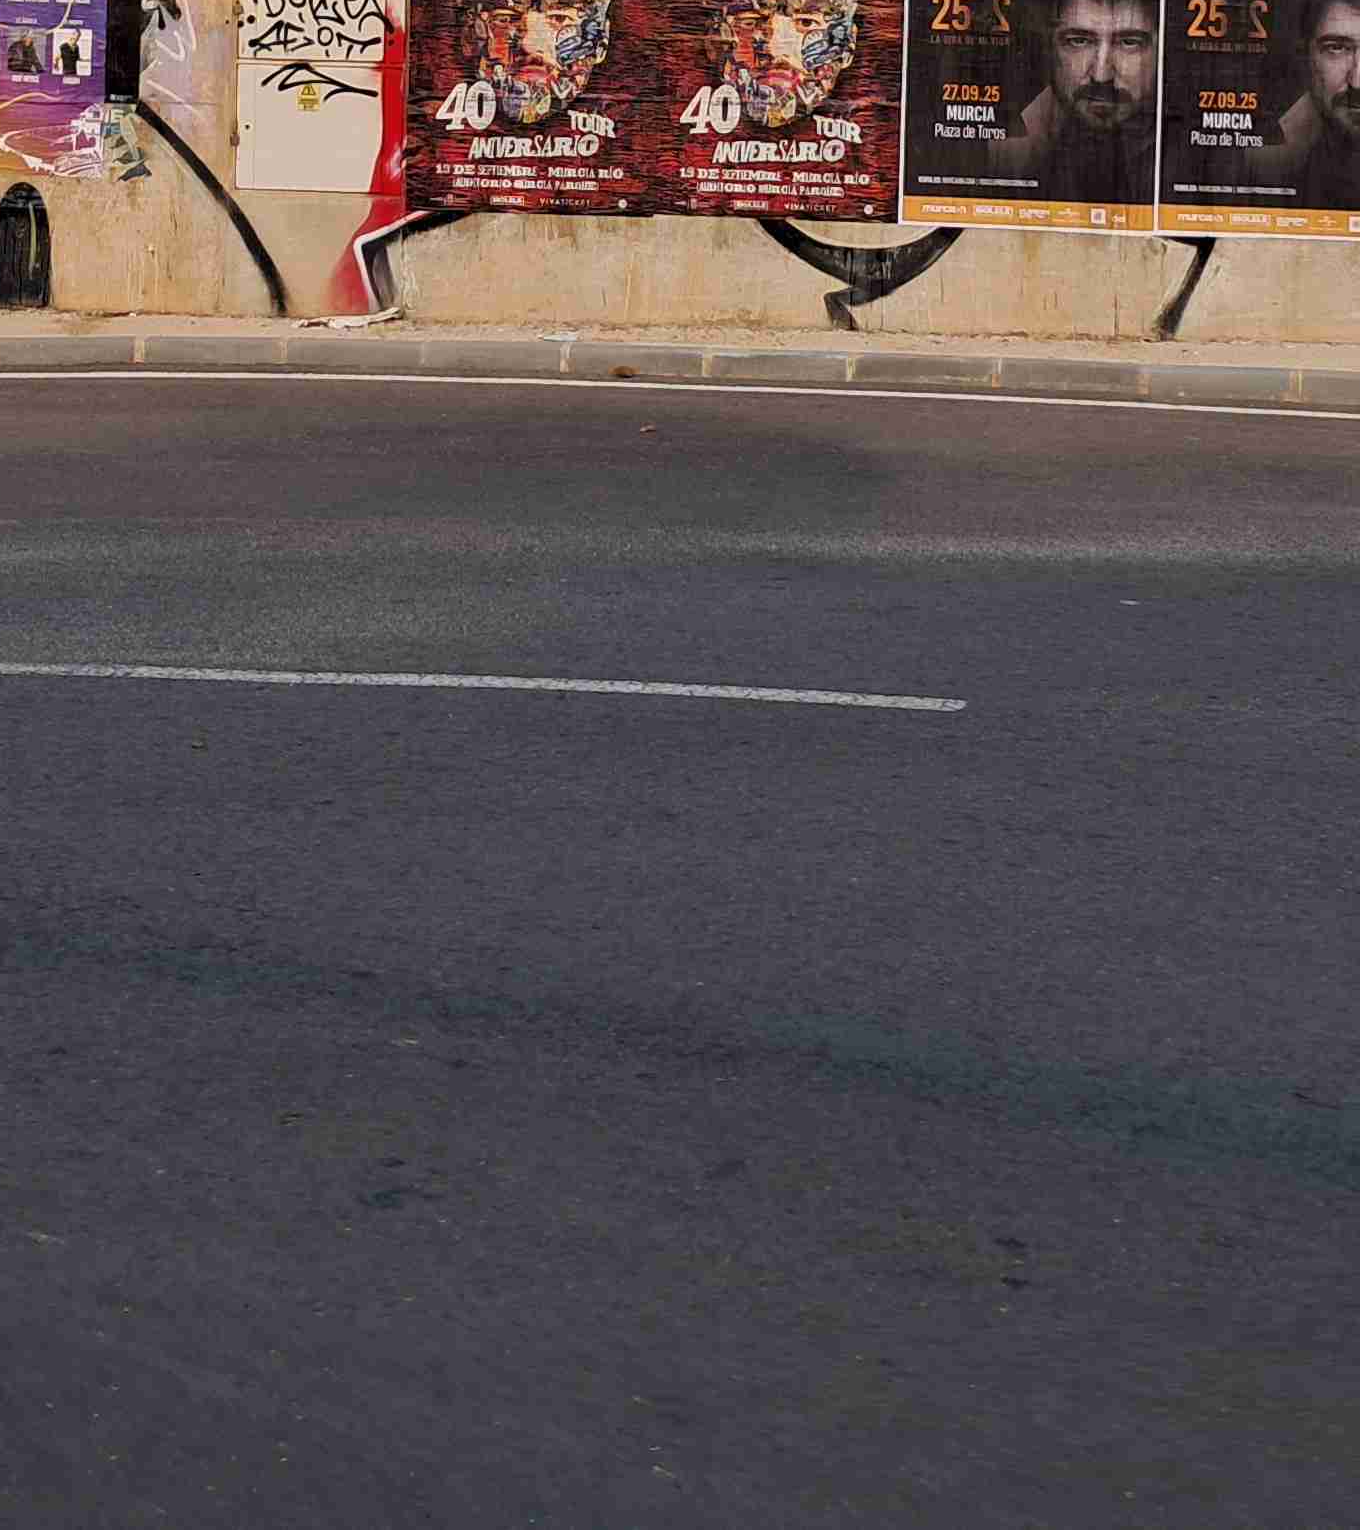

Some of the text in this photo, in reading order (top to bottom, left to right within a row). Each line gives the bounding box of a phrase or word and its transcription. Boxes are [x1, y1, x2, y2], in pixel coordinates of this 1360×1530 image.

[942, 84, 1001, 102] 27.09.25
[1199, 91, 1258, 110] 27.09.25
[435, 80, 617, 139] 40 TOUR
[679, 83, 863, 145] 40 TOUR
[946, 105, 996, 122] MURCIA
[1202, 112, 1253, 130] MURCIA
[934, 123, 1007, 140] Plaza de Toros
[1190, 131, 1264, 148] Plaza de Toros
[468, 134, 600, 160] ANIVERSARIO
[711, 139, 846, 165] ANIVERSARIO
[452, 164, 476, 176] DE
[548, 166, 596, 179] MURCIA
[696, 168, 720, 181] DE
[791, 171, 841, 185] MURCIA
